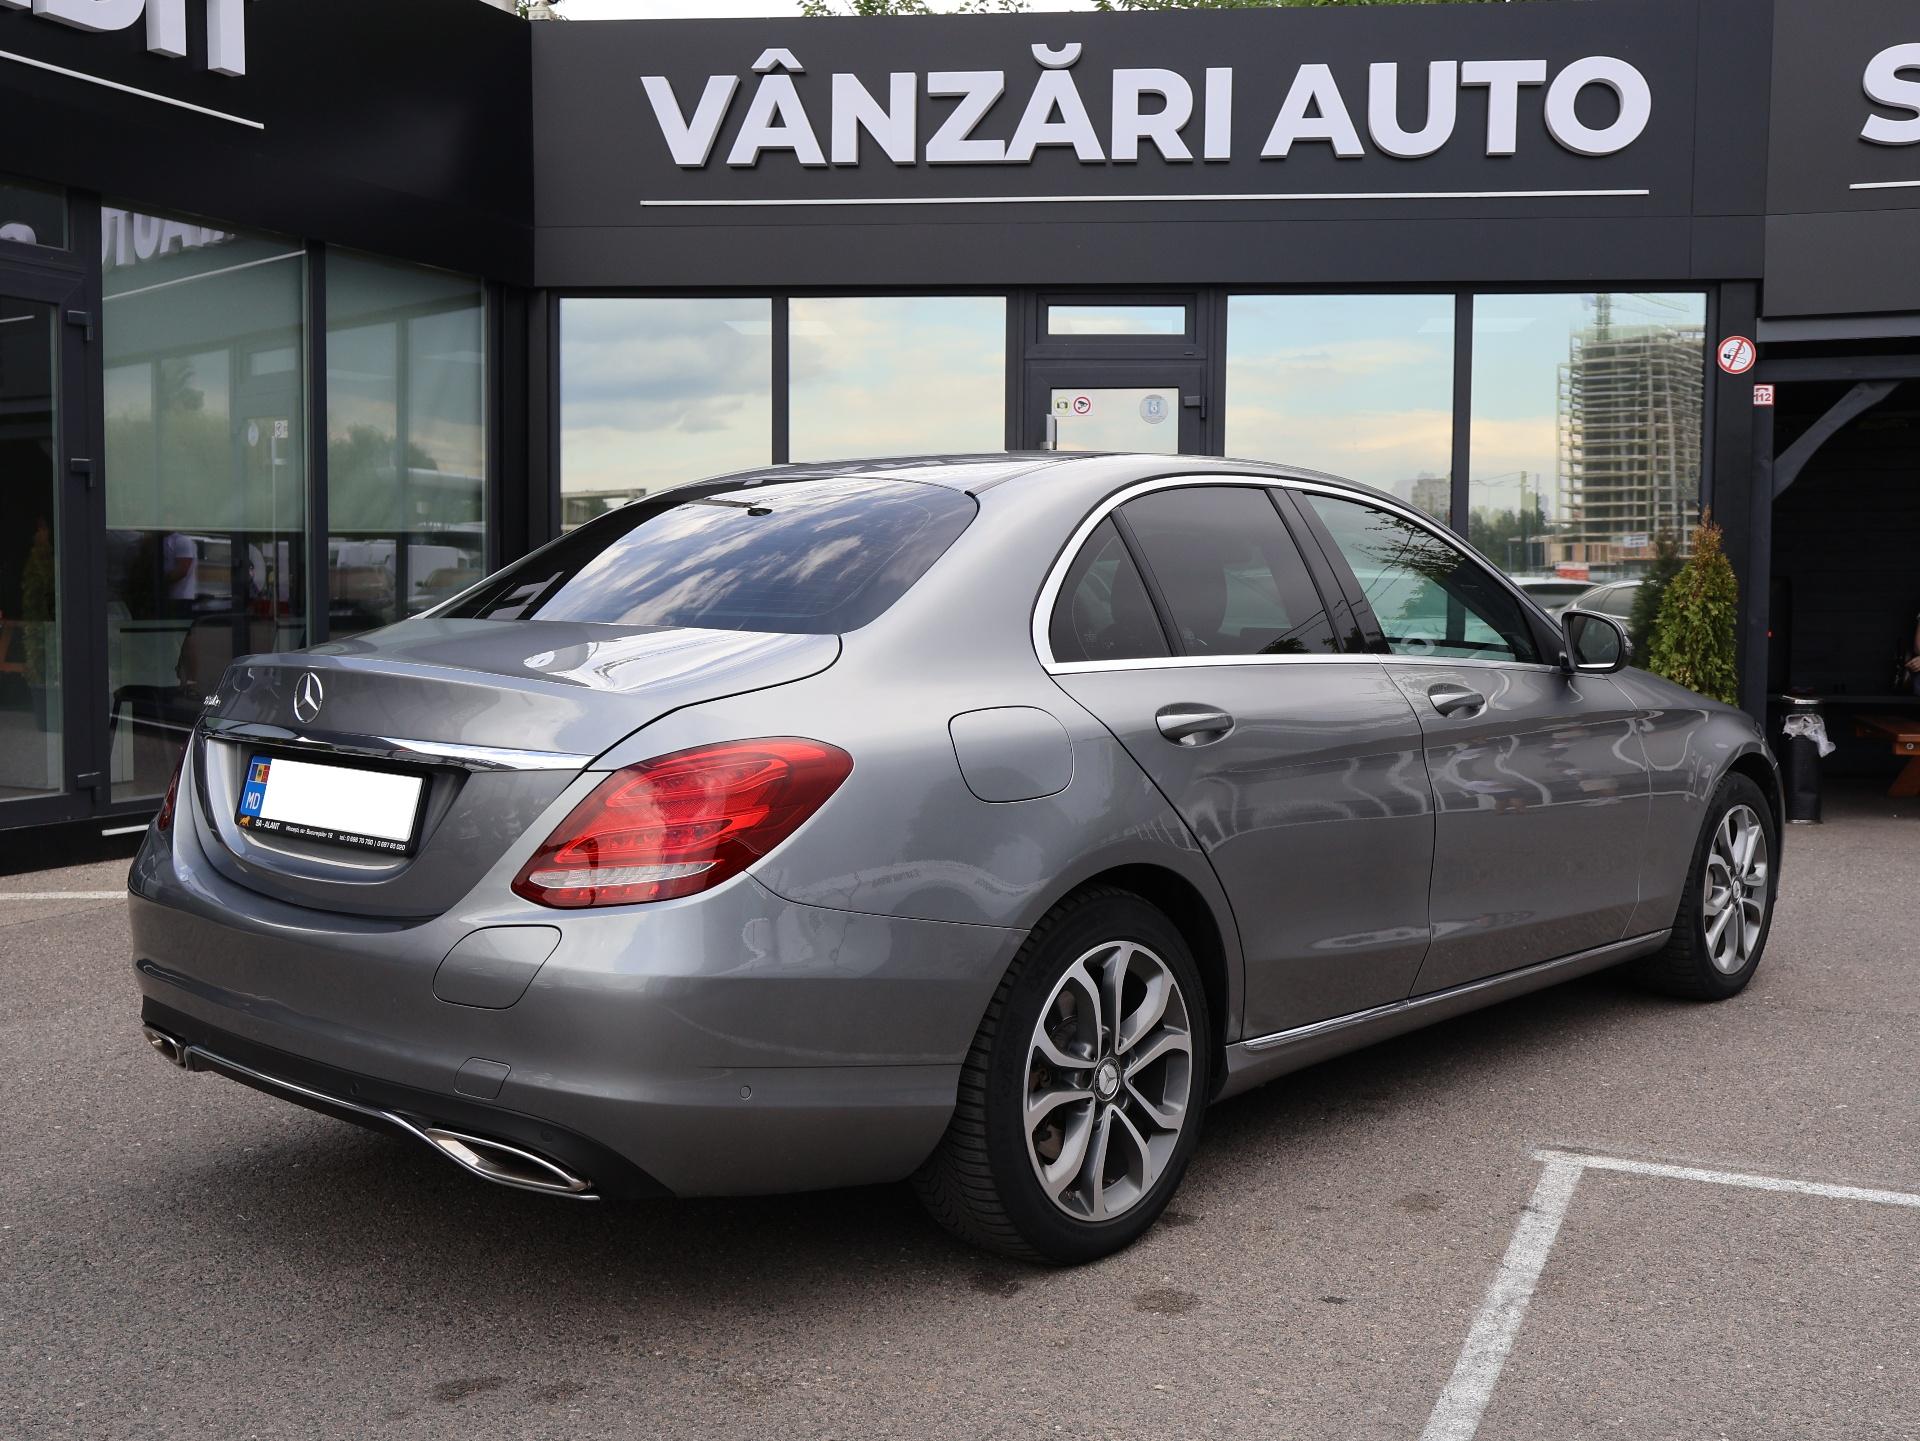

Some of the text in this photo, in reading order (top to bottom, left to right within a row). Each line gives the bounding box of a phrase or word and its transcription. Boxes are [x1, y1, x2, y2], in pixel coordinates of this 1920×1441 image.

[640, 43, 1652, 168] VÂNZĂRI AUTO
[1754, 392, 1772, 402] 112
[245, 791, 261, 810] MD
[264, 820, 281, 831] ALANT
